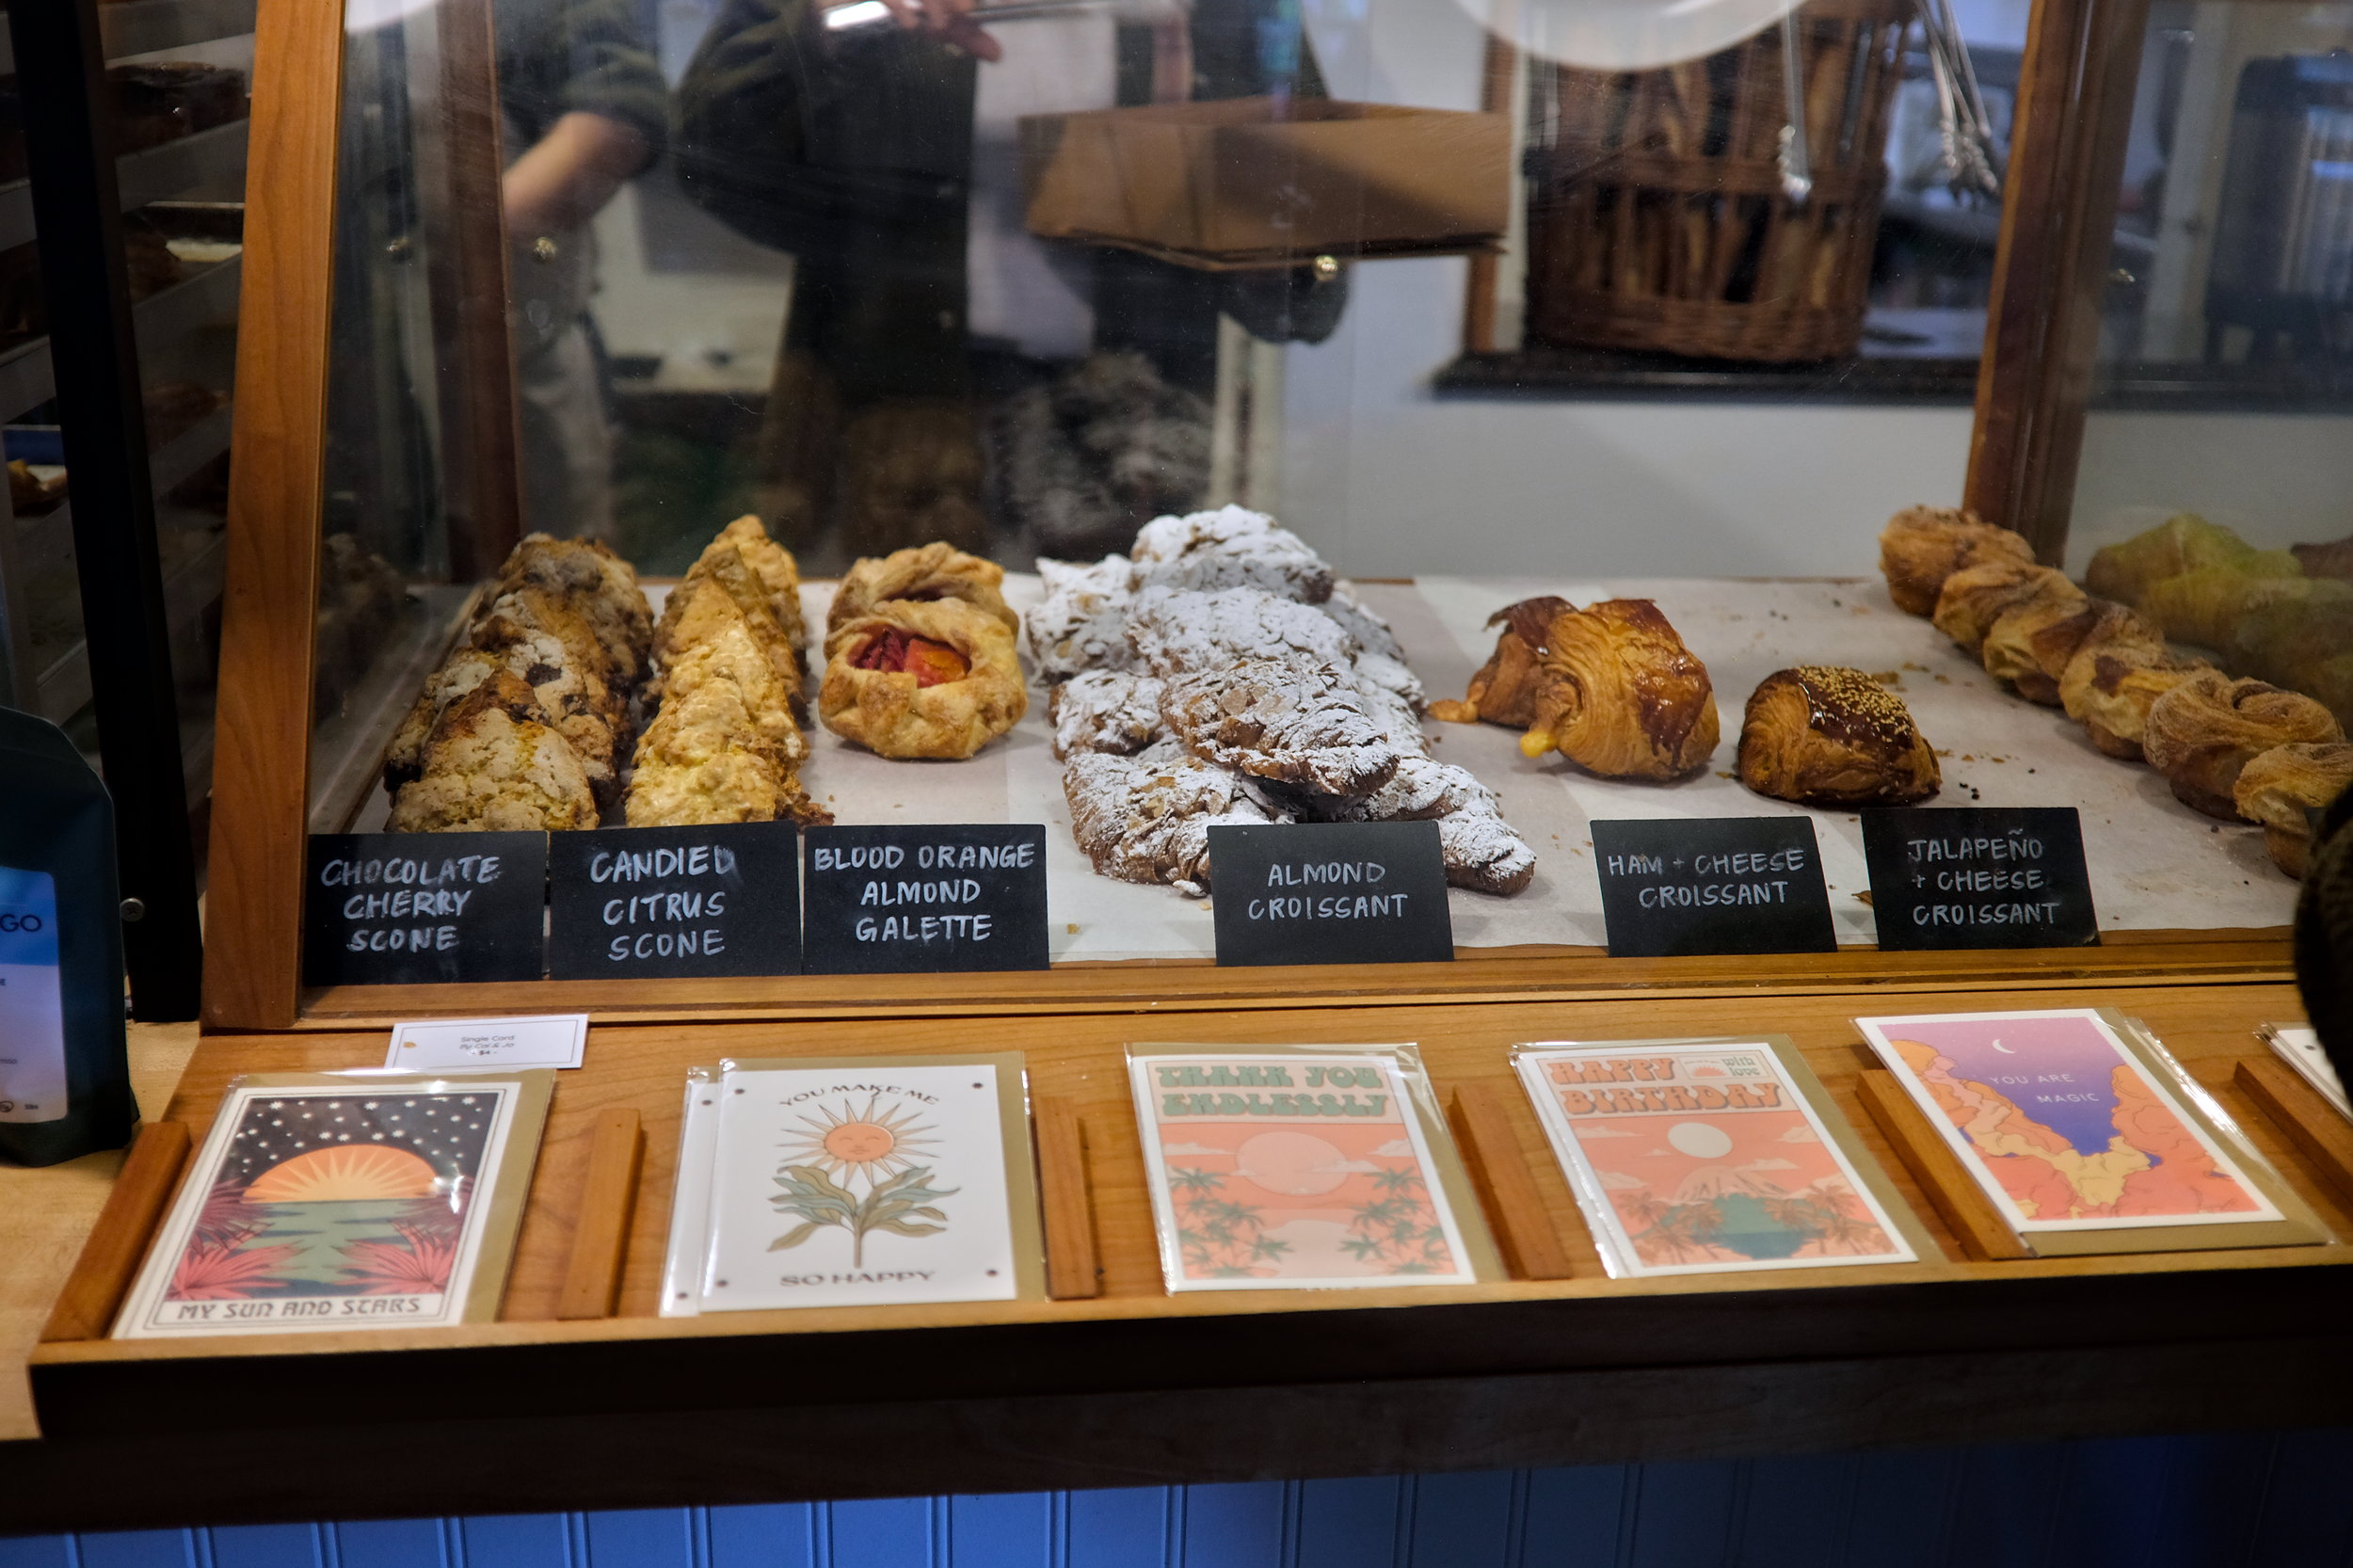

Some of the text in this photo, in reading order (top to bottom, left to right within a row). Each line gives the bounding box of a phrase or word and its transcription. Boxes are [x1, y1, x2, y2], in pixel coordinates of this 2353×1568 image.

[814, 843, 1035, 872] BLOOD ORANGE
[1907, 829, 2043, 863] JALAPEÑO
[320, 856, 500, 888] CHOCOLATE
[589, 844, 738, 884] CANDIED
[1267, 861, 1386, 888] ALMOND
[1608, 855, 1663, 876] HAM
[1695, 850, 1804, 875] CHEESE
[860, 879, 982, 906] ALMOND
[1639, 881, 1788, 908] CROISSANT
[1937, 870, 2043, 892] CHEESE
[343, 888, 472, 920] CHERRY
[602, 891, 726, 926] CITRUS
[1247, 893, 1409, 920] CROISSANT
[1913, 903, 2060, 926] CROISSANT
[347, 925, 458, 952] SCONE
[856, 914, 993, 943] GALETTE
[607, 928, 726, 962] SCONE
[1548, 1056, 1676, 1085] HAPPY
[1721, 1056, 1756, 1066] with
[1729, 1067, 1761, 1077] love
[1156, 1065, 1384, 1089] THANK YOU
[1989, 1073, 2076, 1085] YOU ARE
[778, 1083, 940, 1107] YOU MAKE ME
[1161, 1093, 1388, 1117] ENDLESSLY
[1560, 1081, 1782, 1115] BIRTHDAY
[2036, 1093, 2101, 1104] MAGIC
[779, 1270, 936, 1287] SO HAPPY
[178, 1297, 422, 1320] MY SUN AND STARS
